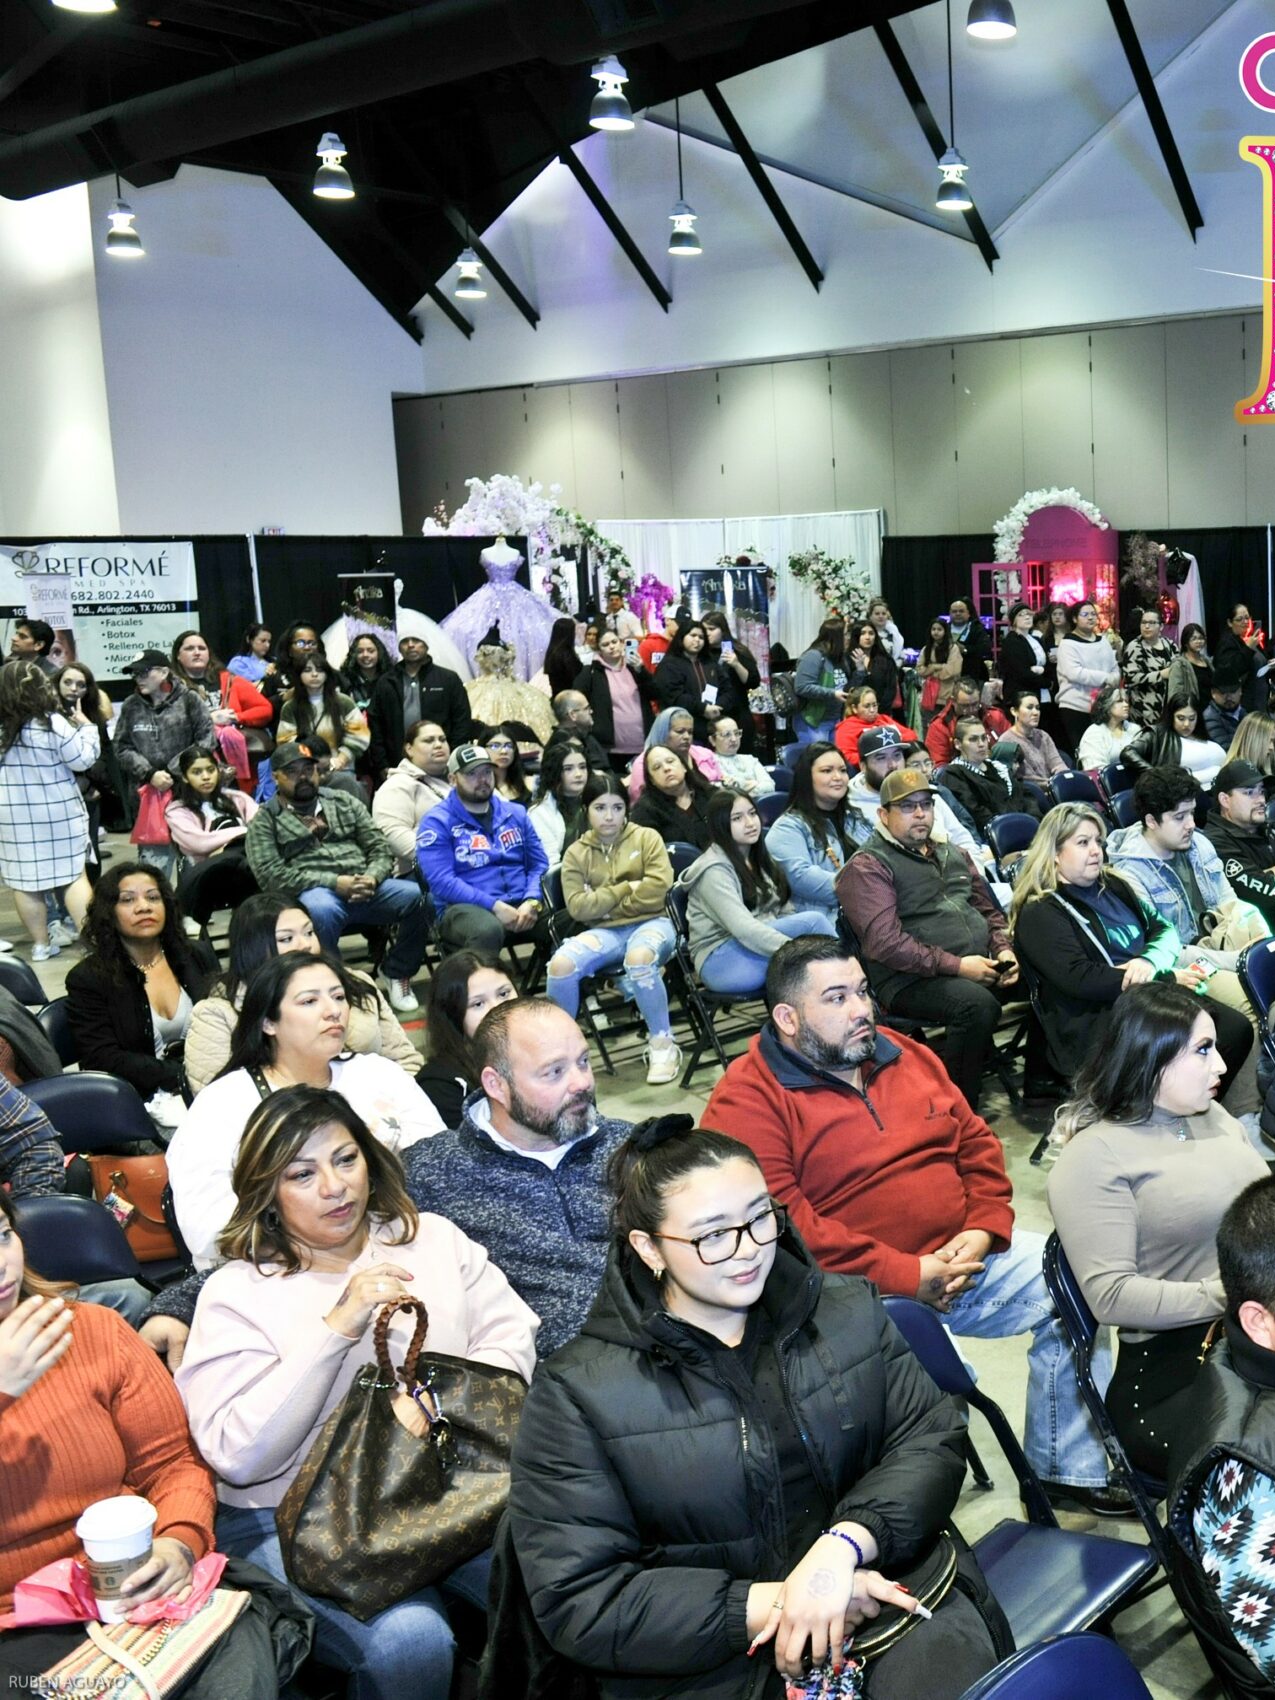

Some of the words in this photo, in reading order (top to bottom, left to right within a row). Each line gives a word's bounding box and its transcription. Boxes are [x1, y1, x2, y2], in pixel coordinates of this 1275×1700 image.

[45, 550, 170, 578] REFORMÉ
[71, 589, 154, 601] 682.802.2440
[97, 604, 138, 615] Arlington,
[139, 604, 151, 612] TX
[152, 603, 176, 611] 76013
[106, 618, 143, 627] Faciales
[107, 631, 136, 639] Botox
[108, 642, 144, 650] Relleno
[147, 641, 160, 649] De
